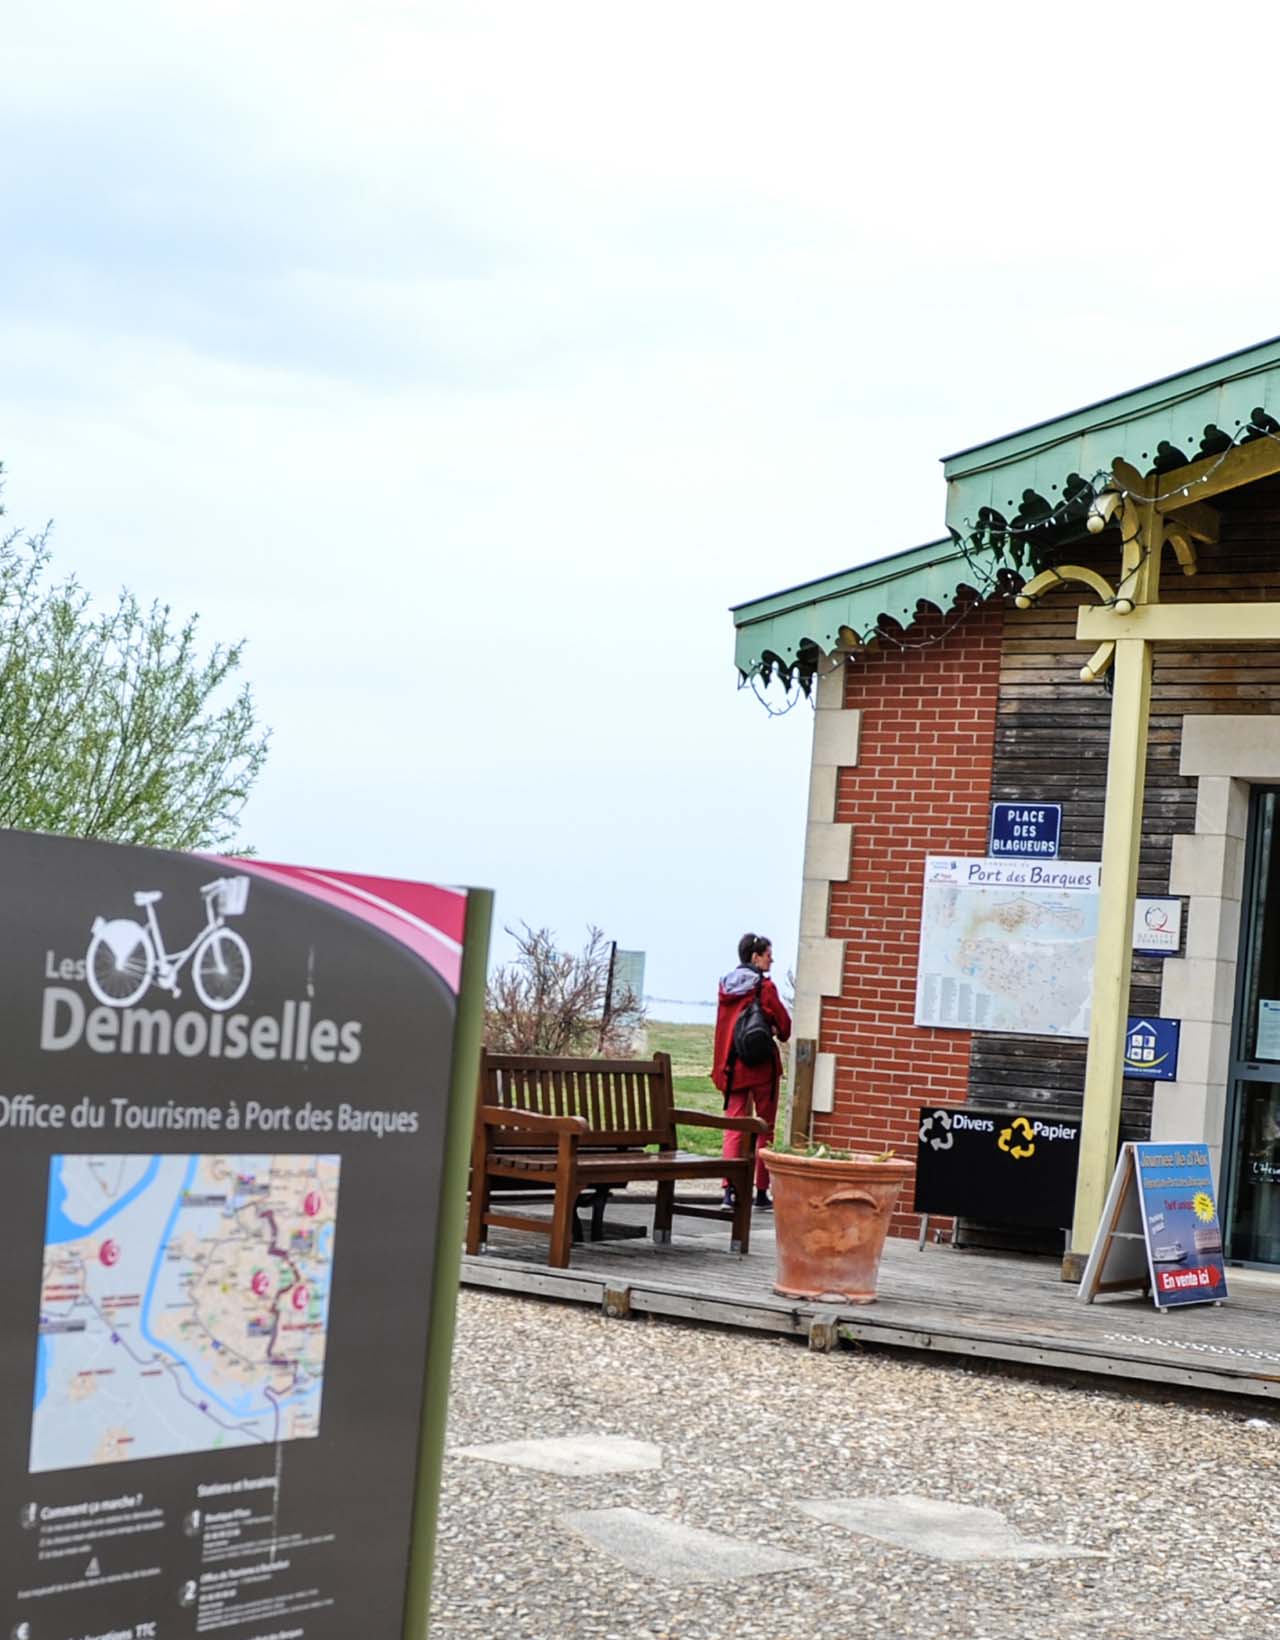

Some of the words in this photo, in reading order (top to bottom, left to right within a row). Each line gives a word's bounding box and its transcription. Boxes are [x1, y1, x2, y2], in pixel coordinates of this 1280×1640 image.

[1008, 810, 1045, 823] PLACE
[1013, 825, 1037, 837] DES
[993, 839, 1056, 853] BLAGUEURS
[968, 864, 1001, 882] Port
[1006, 872, 1026, 882] des
[1030, 866, 1092, 887] Barques
[45, 950, 86, 980] Les
[40, 986, 362, 1064] Demoiselles
[71, 1097, 105, 1129] du
[110, 1098, 223, 1130] Tourisme
[225, 1100, 240, 1130] à
[245, 1100, 291, 1131] Port
[295, 1102, 333, 1131] des
[338, 1103, 418, 1138] Barques
[953, 1115, 994, 1132] Divers
[1033, 1121, 1077, 1141] Papier
[1163, 1273, 1175, 1288] En
[1176, 1274, 1198, 1287] vente
[1199, 1268, 1209, 1284] ici
[40, 1503, 88, 1520] Comment
[101, 1495, 135, 1510] marche
[192, 1509, 201, 1528] 1
[184, 1580, 197, 1600] 2
